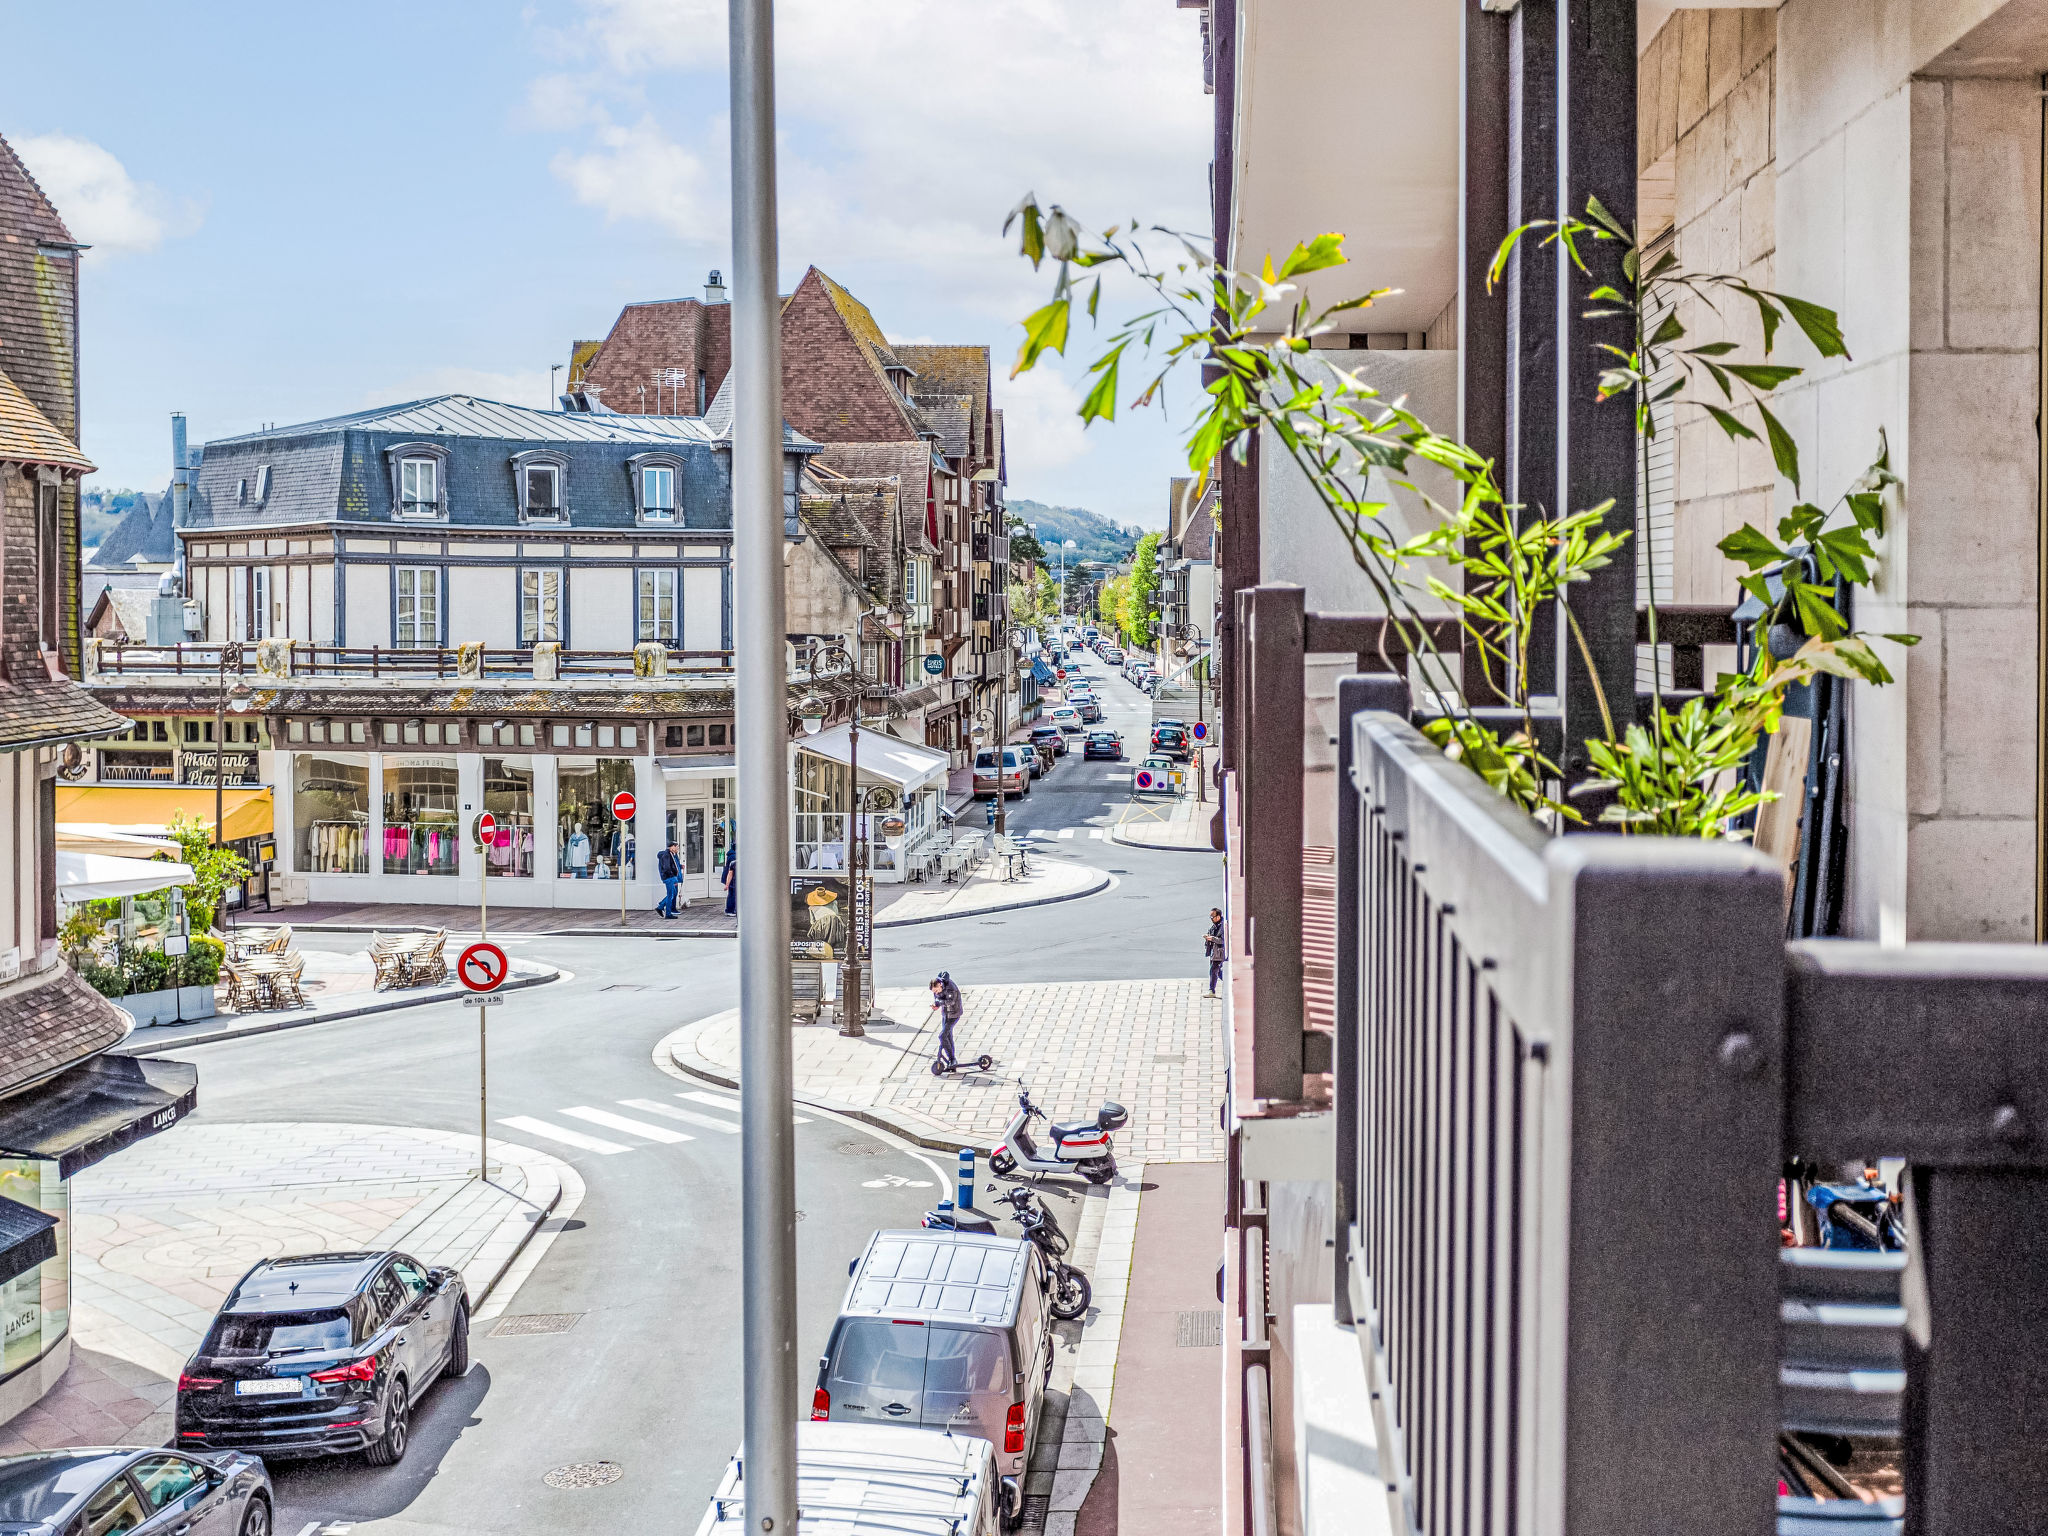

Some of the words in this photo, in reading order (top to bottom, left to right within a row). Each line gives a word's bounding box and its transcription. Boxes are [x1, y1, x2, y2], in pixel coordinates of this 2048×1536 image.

[189, 770, 243, 786] Pizzria
[856, 879, 864, 900] DOS
[856, 901, 864, 915] DE
[5, 1309, 35, 1336] LANCEL
